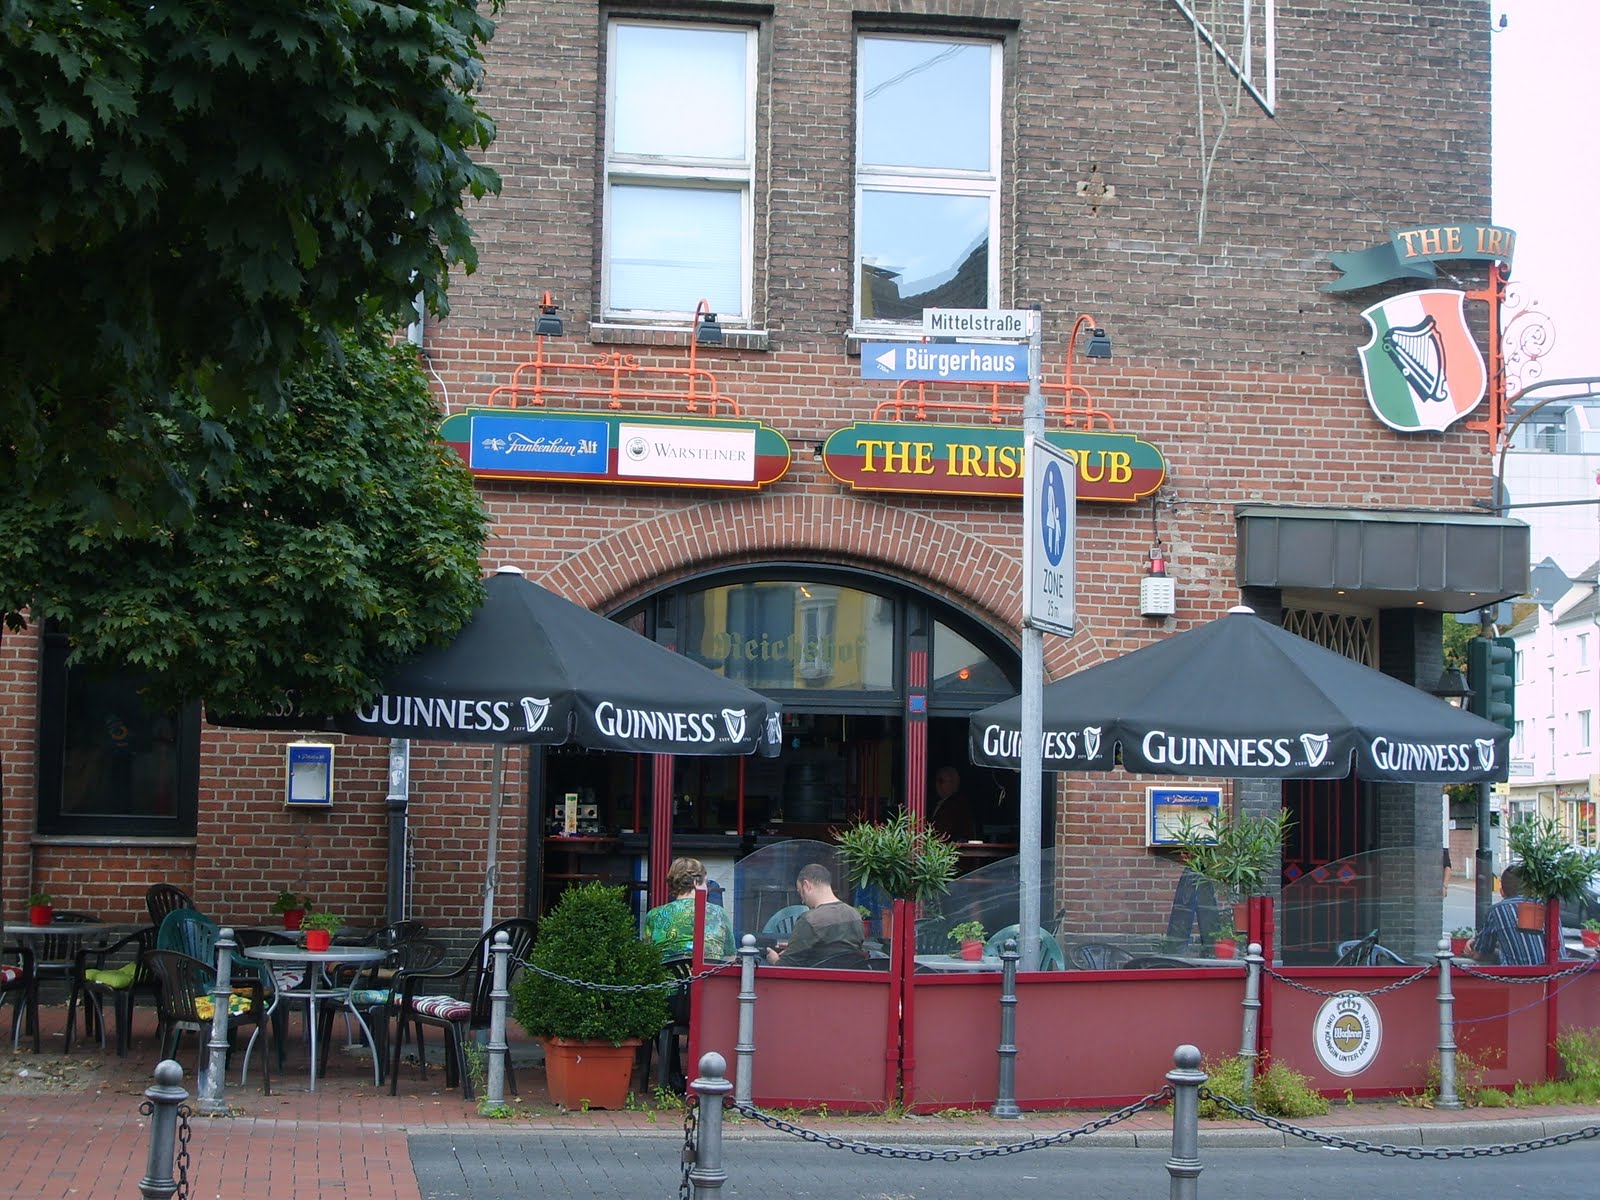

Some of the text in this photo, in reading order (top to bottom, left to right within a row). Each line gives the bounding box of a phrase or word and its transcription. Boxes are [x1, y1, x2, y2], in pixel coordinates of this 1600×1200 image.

[1397, 226, 1514, 258] THE IRI
[931, 314, 1022, 333] Mittelstraße
[905, 348, 1016, 376] Bürgerhaus
[505, 432, 598, 456] Frankenheim Alt
[856, 440, 935, 475] THE
[1043, 568, 1063, 599] ZONE
[594, 700, 716, 743] GUINNESS
[1142, 730, 1292, 768] GUINNESS
[1371, 736, 1470, 772] GUINNESS
[1338, 1053, 1360, 1062] UNTER
[1358, 1041, 1369, 1056] DEN
